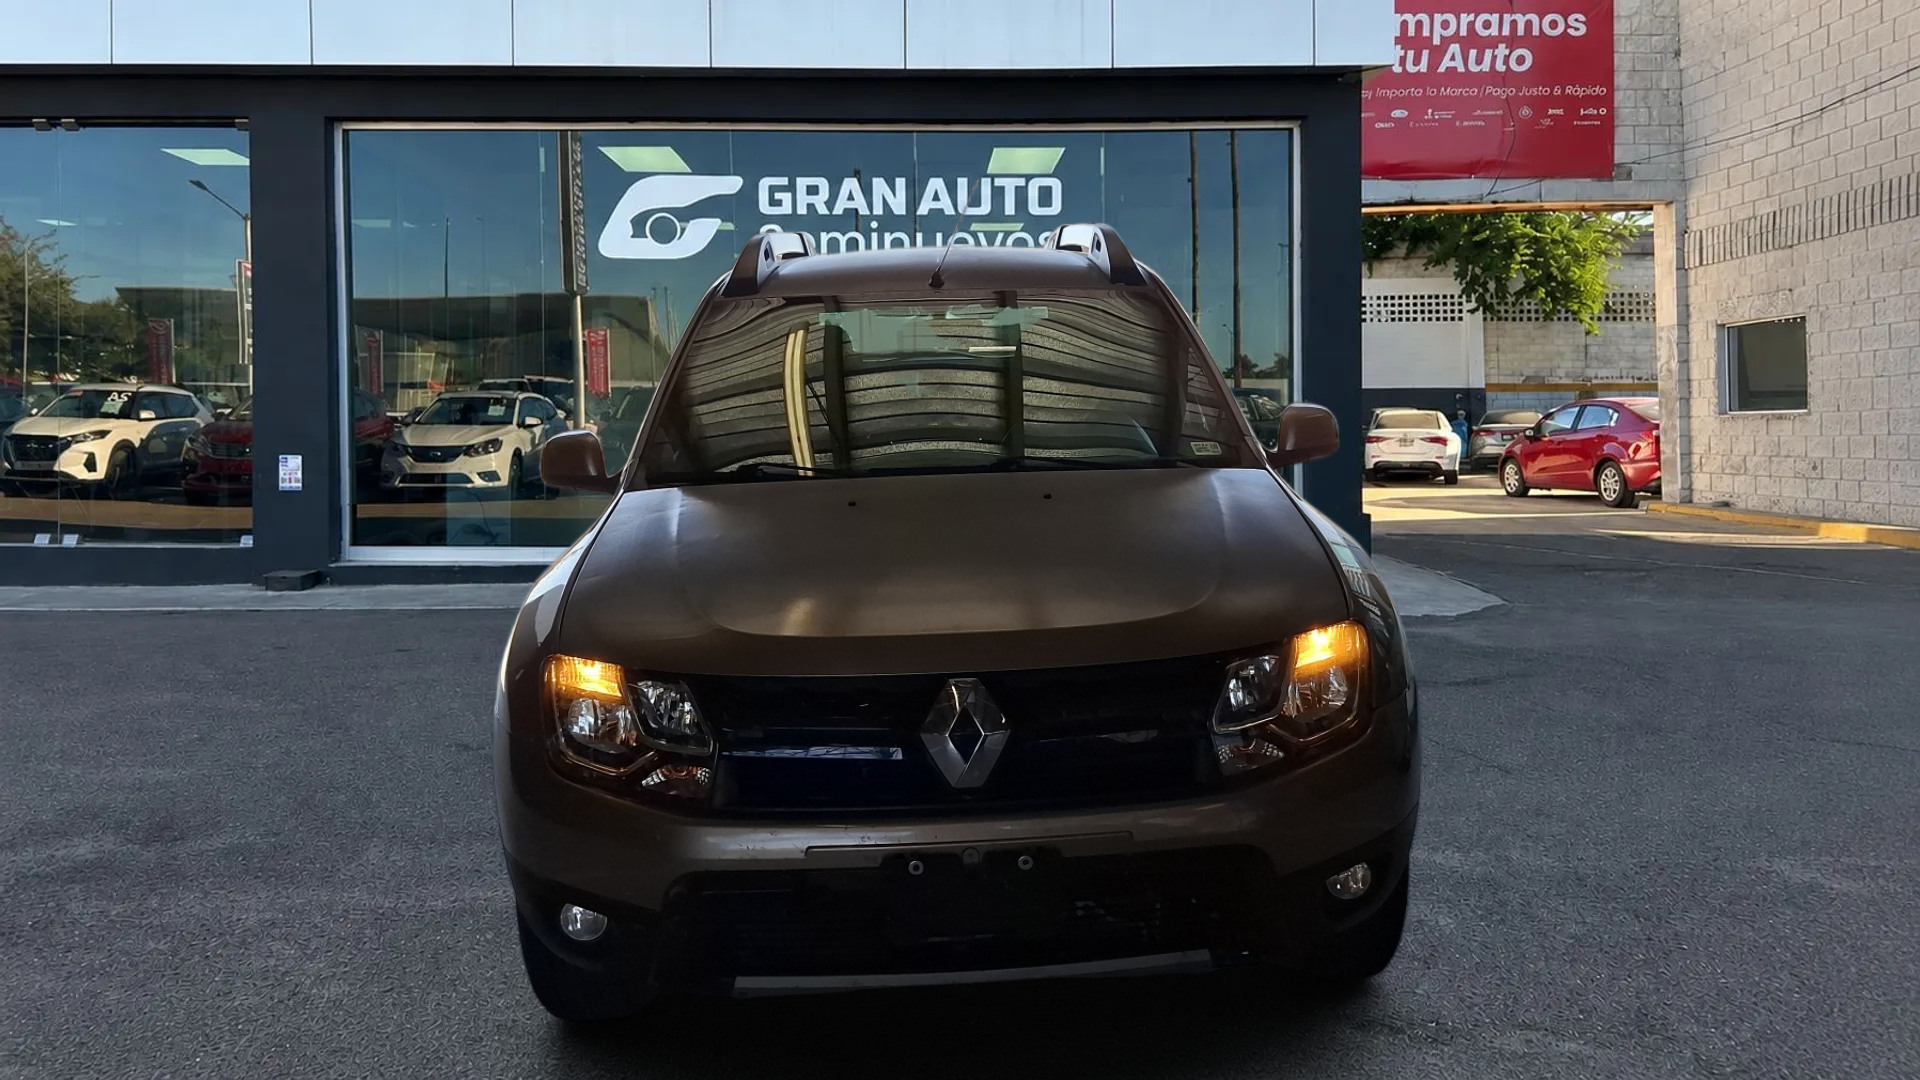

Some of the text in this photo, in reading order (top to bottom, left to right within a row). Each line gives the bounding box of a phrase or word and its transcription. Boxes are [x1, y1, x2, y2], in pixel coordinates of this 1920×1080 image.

[1394, 12, 1587, 45] mpramos
[1392, 43, 1533, 73] tu Auto
[1375, 87, 1423, 99] Importa
[1426, 86, 1437, 96] la
[1440, 86, 1478, 96] Marca
[1518, 86, 1551, 96] Justo
[1553, 86, 1562, 95] &
[1565, 85, 1607, 98] Rápido
[758, 176, 1063, 215] GRAN AUTO
